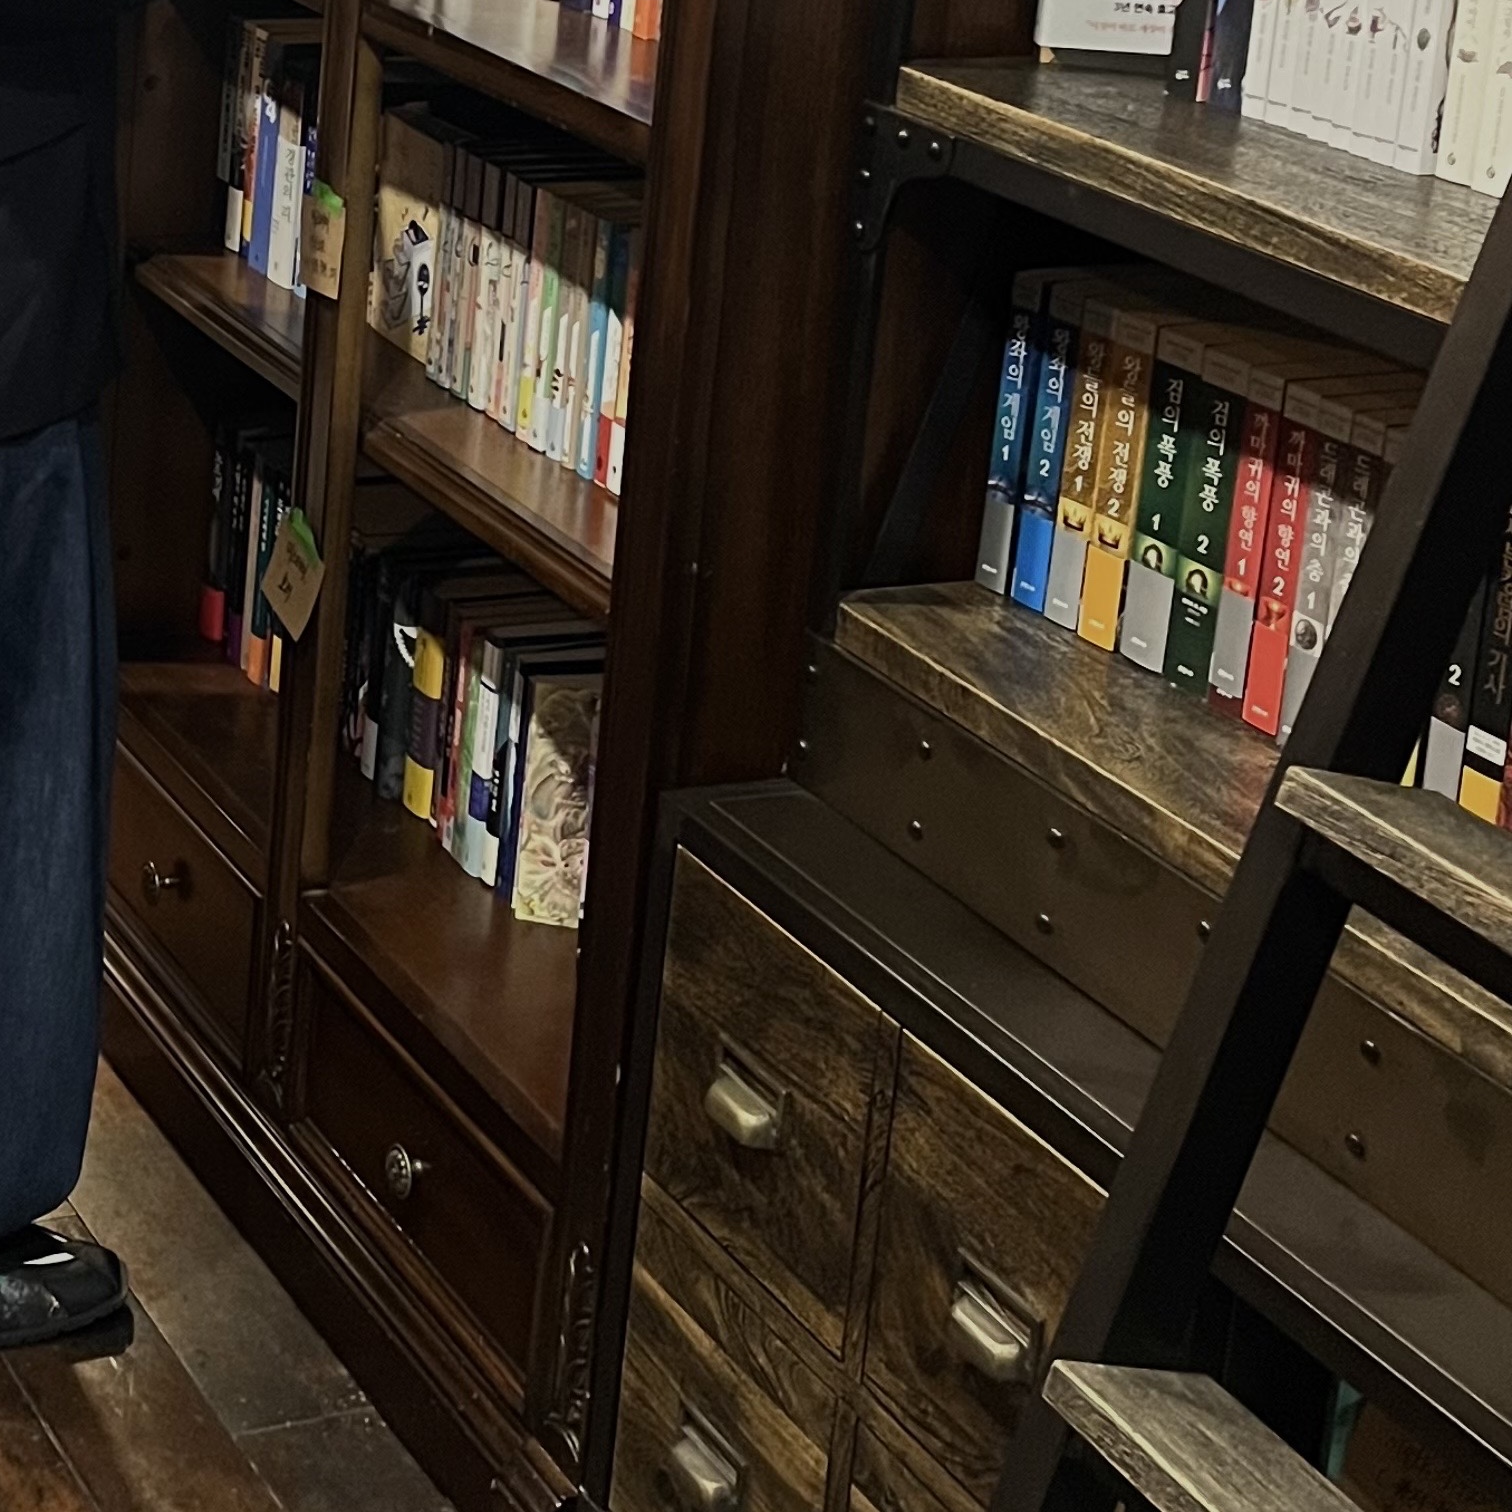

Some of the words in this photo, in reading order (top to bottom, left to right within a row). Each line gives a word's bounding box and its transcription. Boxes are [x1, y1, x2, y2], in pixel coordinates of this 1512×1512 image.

[1006, 315, 1030, 389] 왕좌의
[1046, 328, 1071, 403] 왕좌의
[1000, 393, 1021, 440] 게임
[1040, 405, 1061, 454] 게임
[1161, 378, 1184, 433] 검의
[1206, 400, 1230, 456] 검의
[1001, 445, 1010, 461] 1
[1039, 459, 1051, 477] 2
[1072, 420, 1095, 471] 전쟁
[1108, 441, 1130, 494] 전쟁
[1154, 433, 1178, 489] 폭풍
[1243, 412, 1271, 504] 까마귀의
[1074, 475, 1083, 492] 1
[1198, 456, 1224, 513] 폭풍
[1280, 431, 1306, 522] 까마귀의
[1107, 498, 1120, 517] 2
[1151, 513, 1161, 531] 1
[1238, 504, 1258, 552] 향연
[1196, 534, 1209, 554] 2
[1237, 558, 1246, 576] 1
[1275, 523, 1295, 572] 향연
[1272, 576, 1285, 597] 2
[1307, 591, 1317, 609] 1
[1448, 664, 1462, 686] 2
